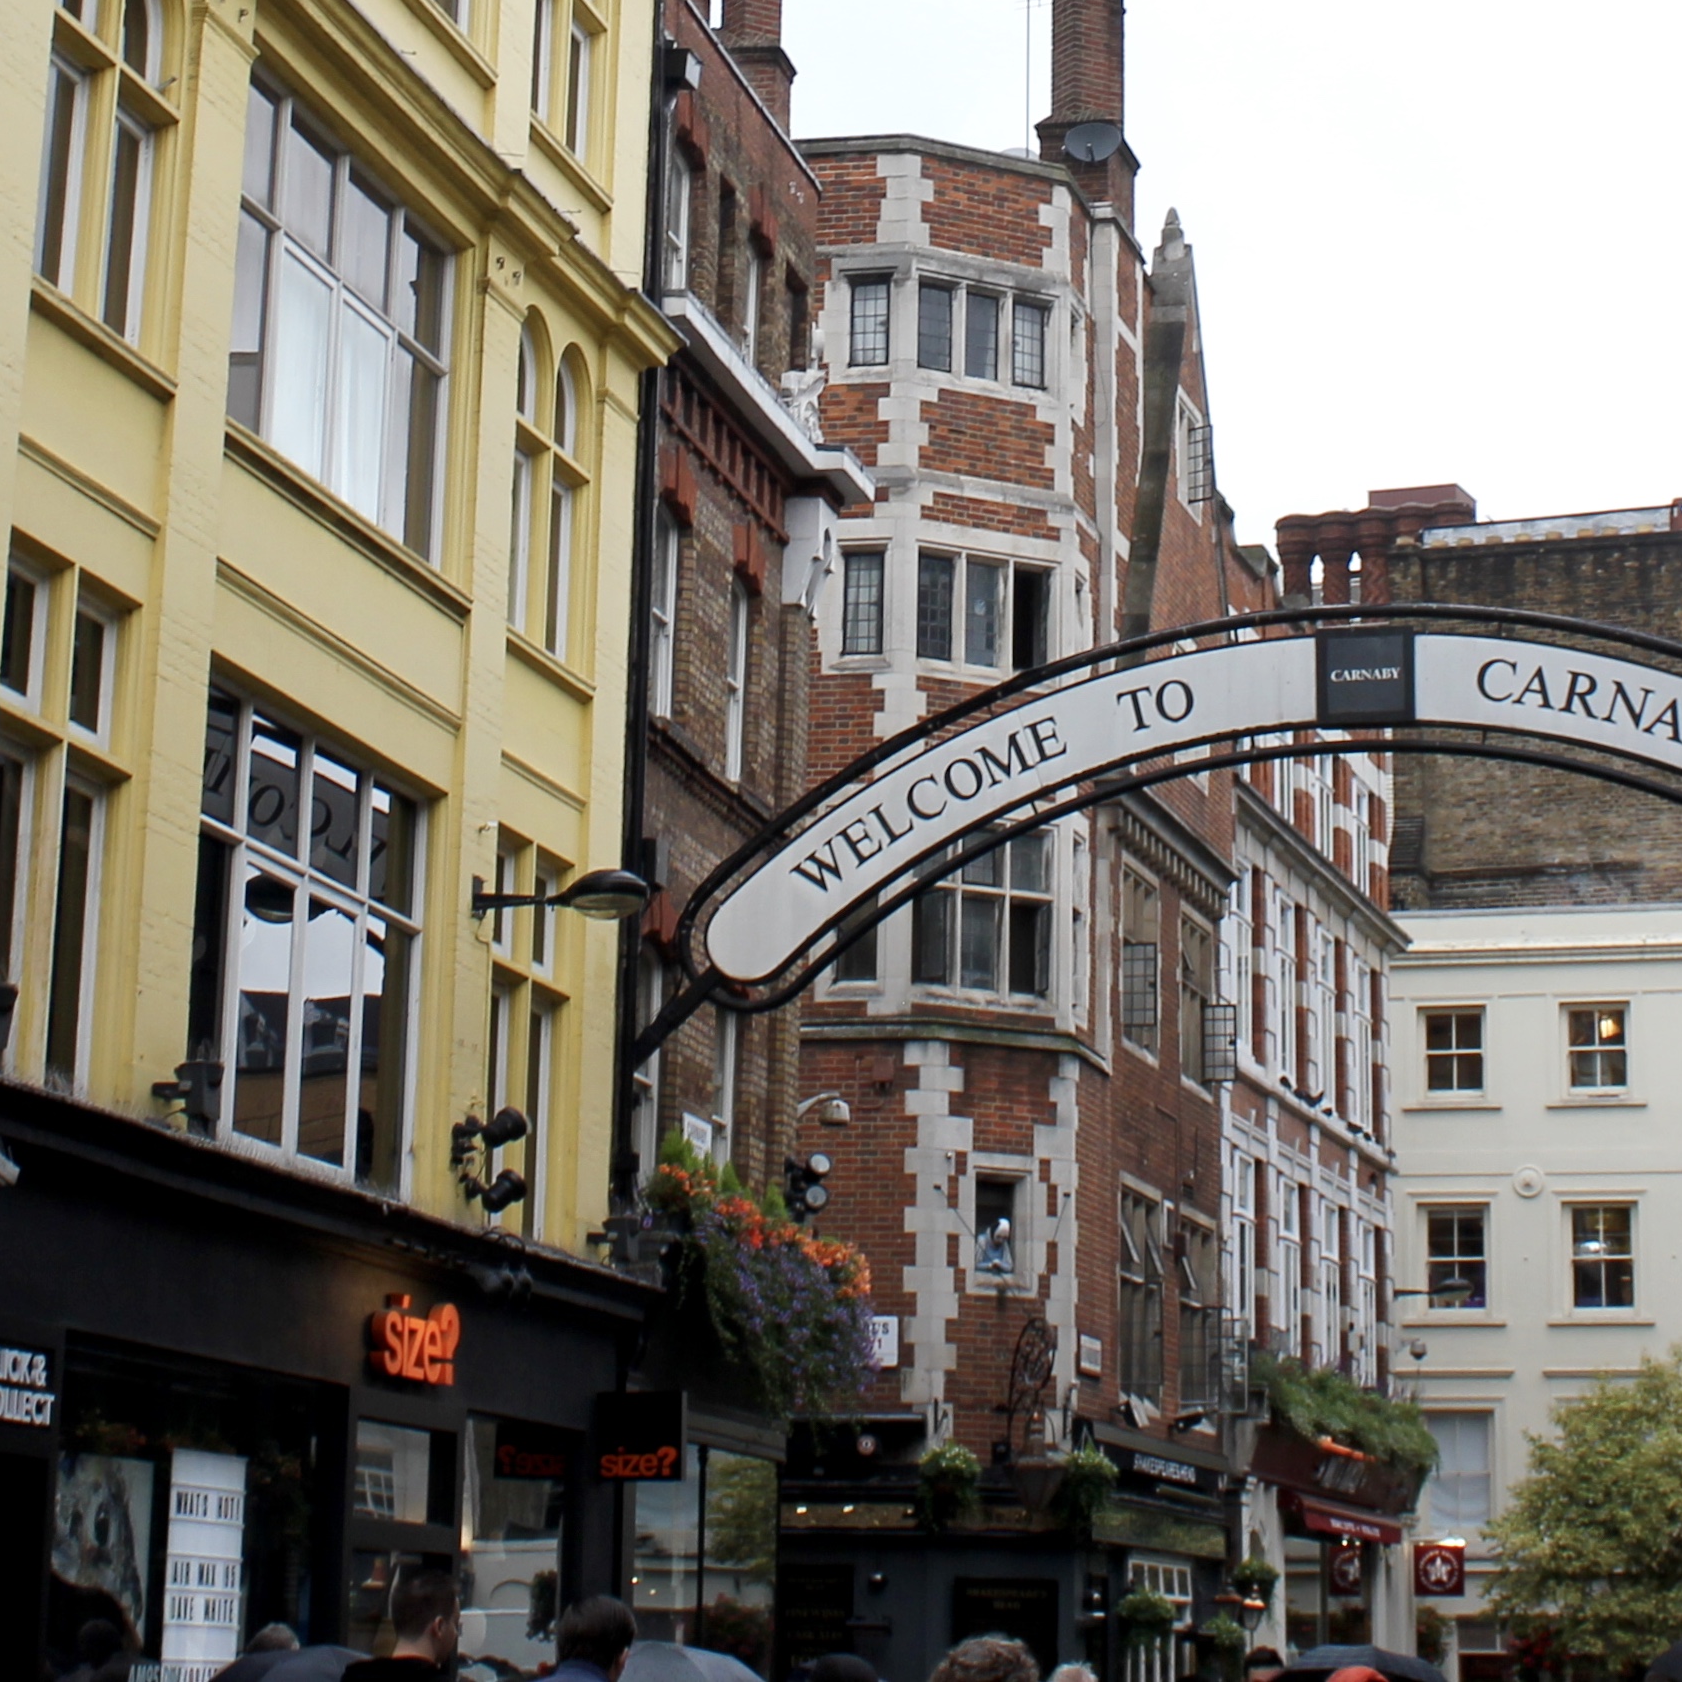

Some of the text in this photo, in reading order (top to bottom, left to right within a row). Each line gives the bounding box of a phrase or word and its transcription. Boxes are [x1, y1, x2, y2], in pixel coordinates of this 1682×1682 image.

[1330, 666, 1401, 683] CARNABY
[789, 716, 1068, 892] WELCOME
[1116, 679, 1195, 733] TO
[378, 1294, 460, 1386] size?
[598, 1445, 680, 1478] size?
[172, 1560, 191, 1585] AIR
